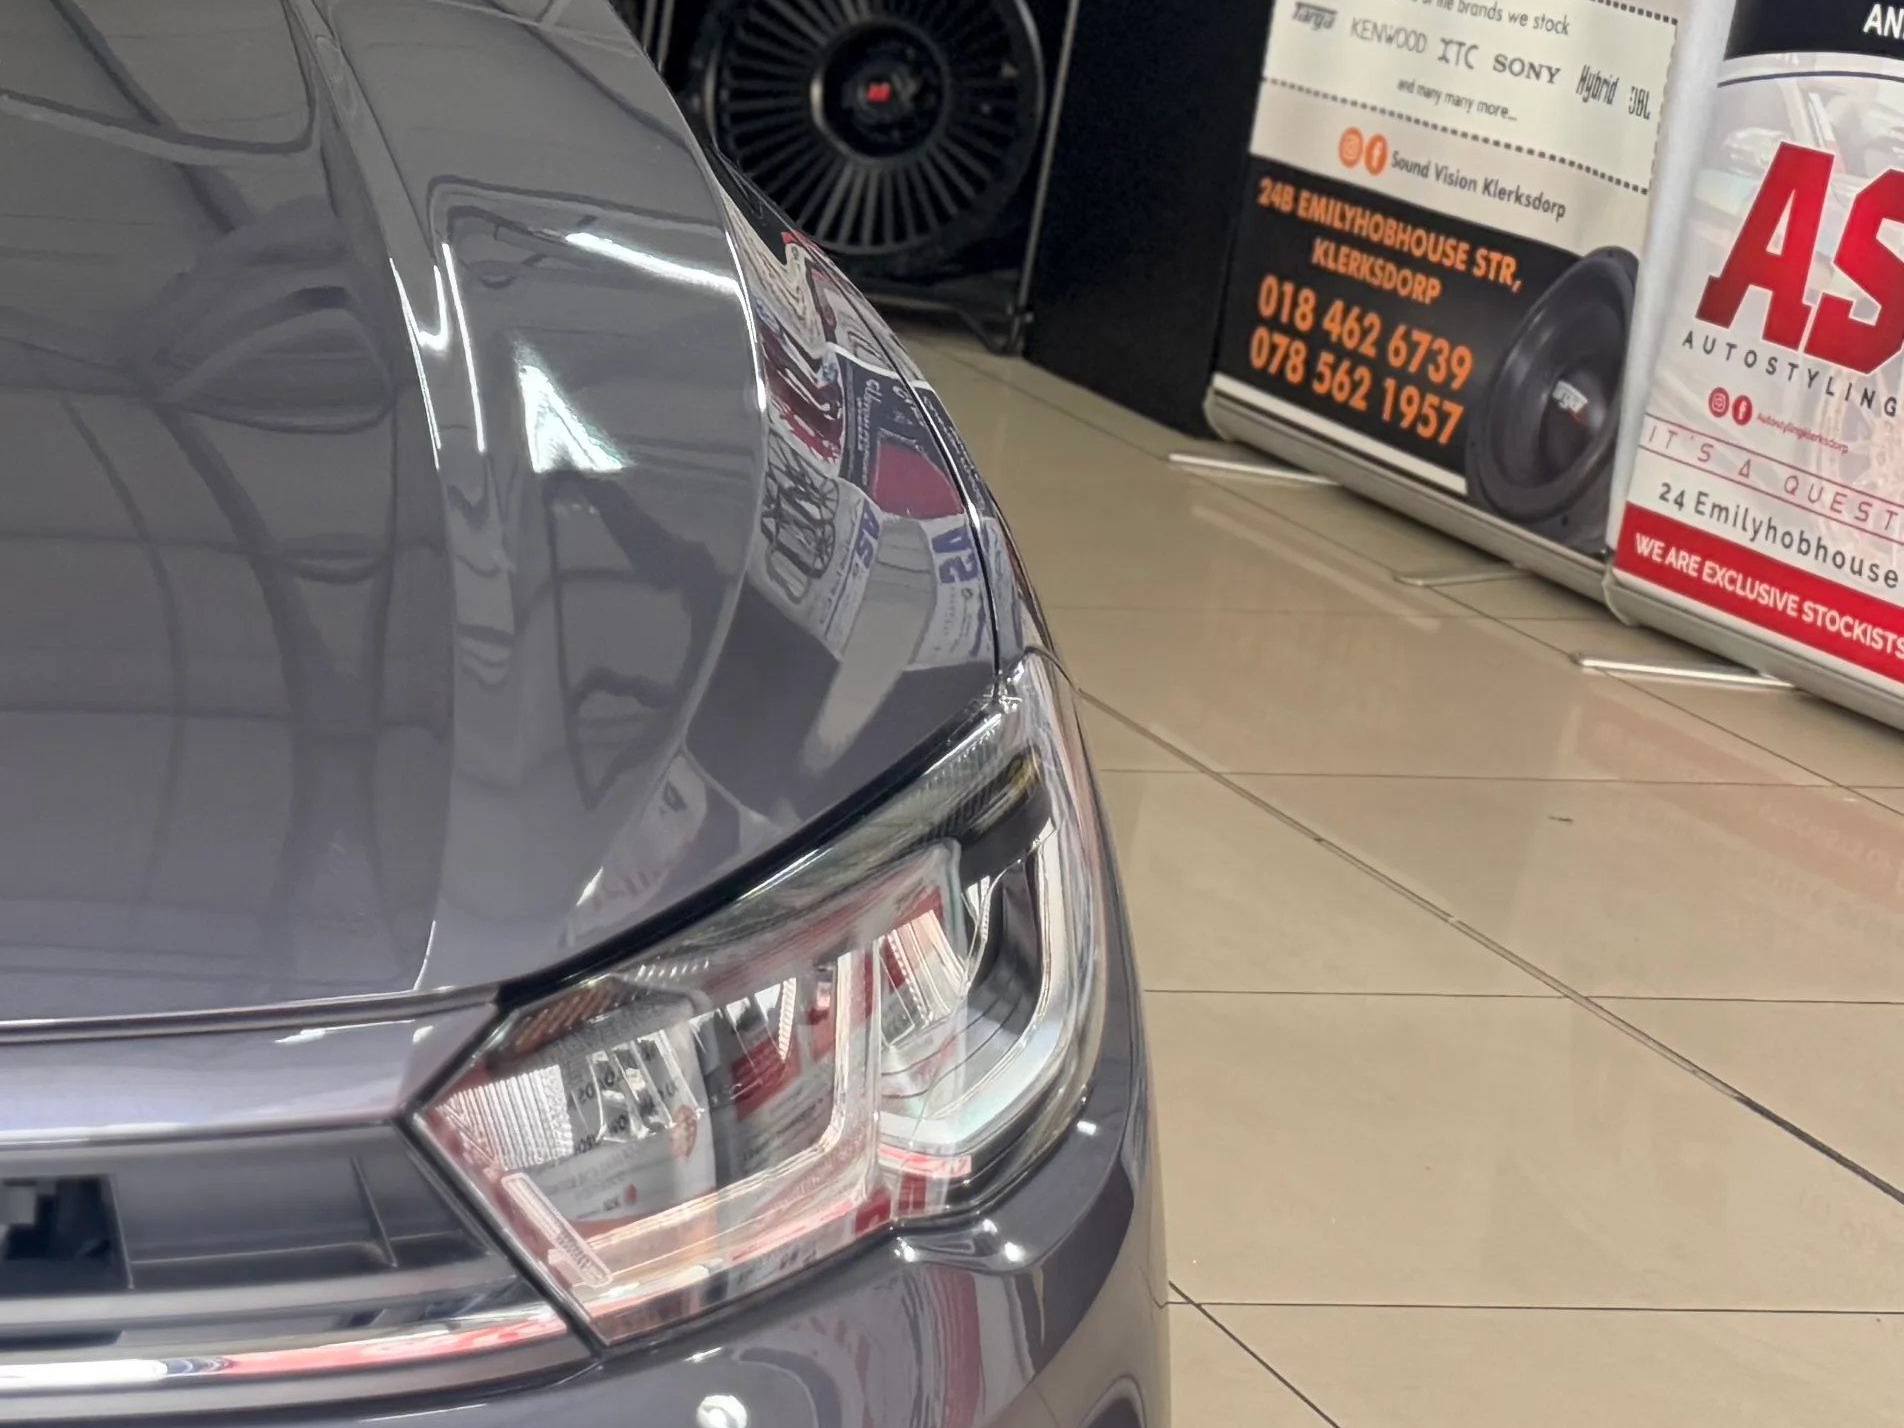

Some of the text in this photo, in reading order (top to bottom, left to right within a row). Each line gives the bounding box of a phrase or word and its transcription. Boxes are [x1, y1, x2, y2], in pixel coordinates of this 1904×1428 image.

[1350, 16, 1428, 54] KENWOOD
[1492, 52, 1562, 85] SONY
[1575, 63, 1620, 106] Hybrid
[1507, 10, 1530, 28] we
[1532, 14, 1571, 36] stock
[1444, 91, 1475, 114] many
[1391, 150, 1567, 223] Sound Vision Klerksdorp
[1257, 176, 1524, 293] 24B EMILYHOBHOUSE STR,
[1311, 236, 1443, 305] KLERKSDORP
[1258, 274, 1474, 391] 018 462 6739
[1681, 329, 1898, 418] AUTOSTYLING
[1249, 325, 1465, 446] 078 562 1957
[1658, 481, 1900, 590] 24 Emilyhobhouse
[1634, 532, 1904, 660] WE ARE EXCLUSIVE STOCKISTS
